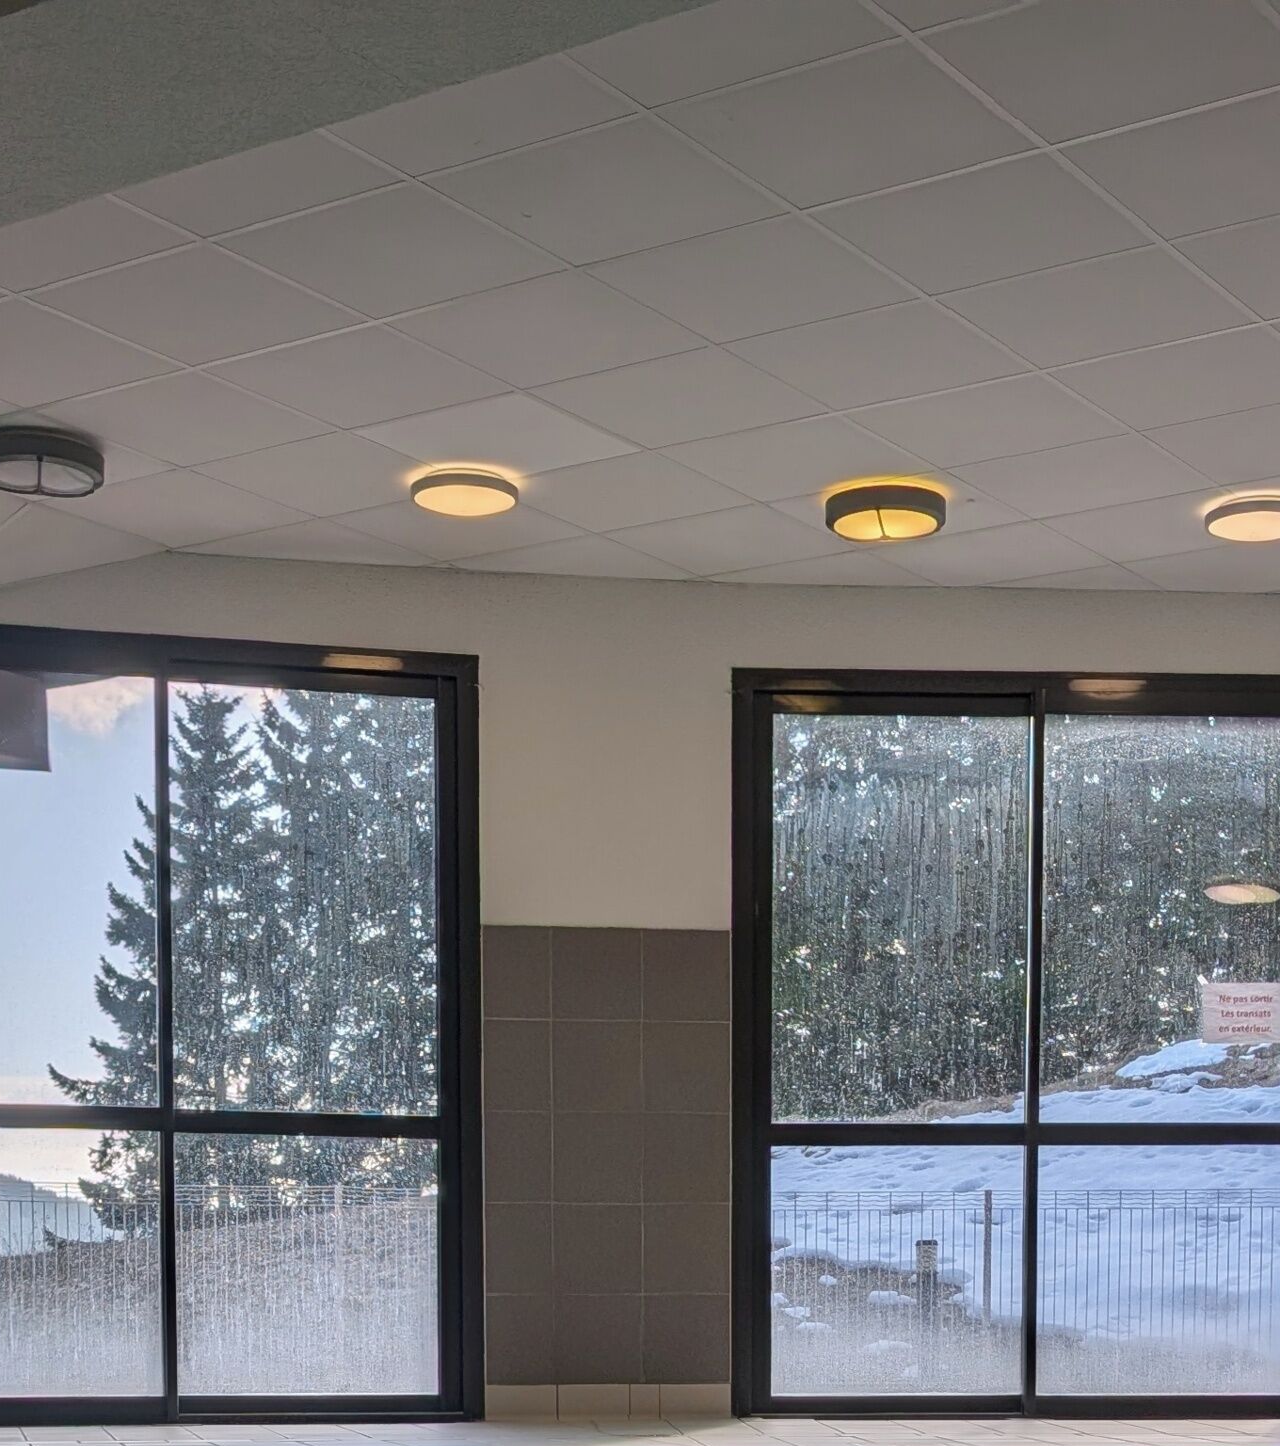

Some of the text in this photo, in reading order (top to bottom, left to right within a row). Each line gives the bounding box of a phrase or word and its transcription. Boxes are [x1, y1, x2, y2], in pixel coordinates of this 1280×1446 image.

[1218, 994, 1273, 1005] Ne pas sortir
[1221, 1009, 1272, 1018] Les transats
[1218, 1025, 1229, 1033] en
